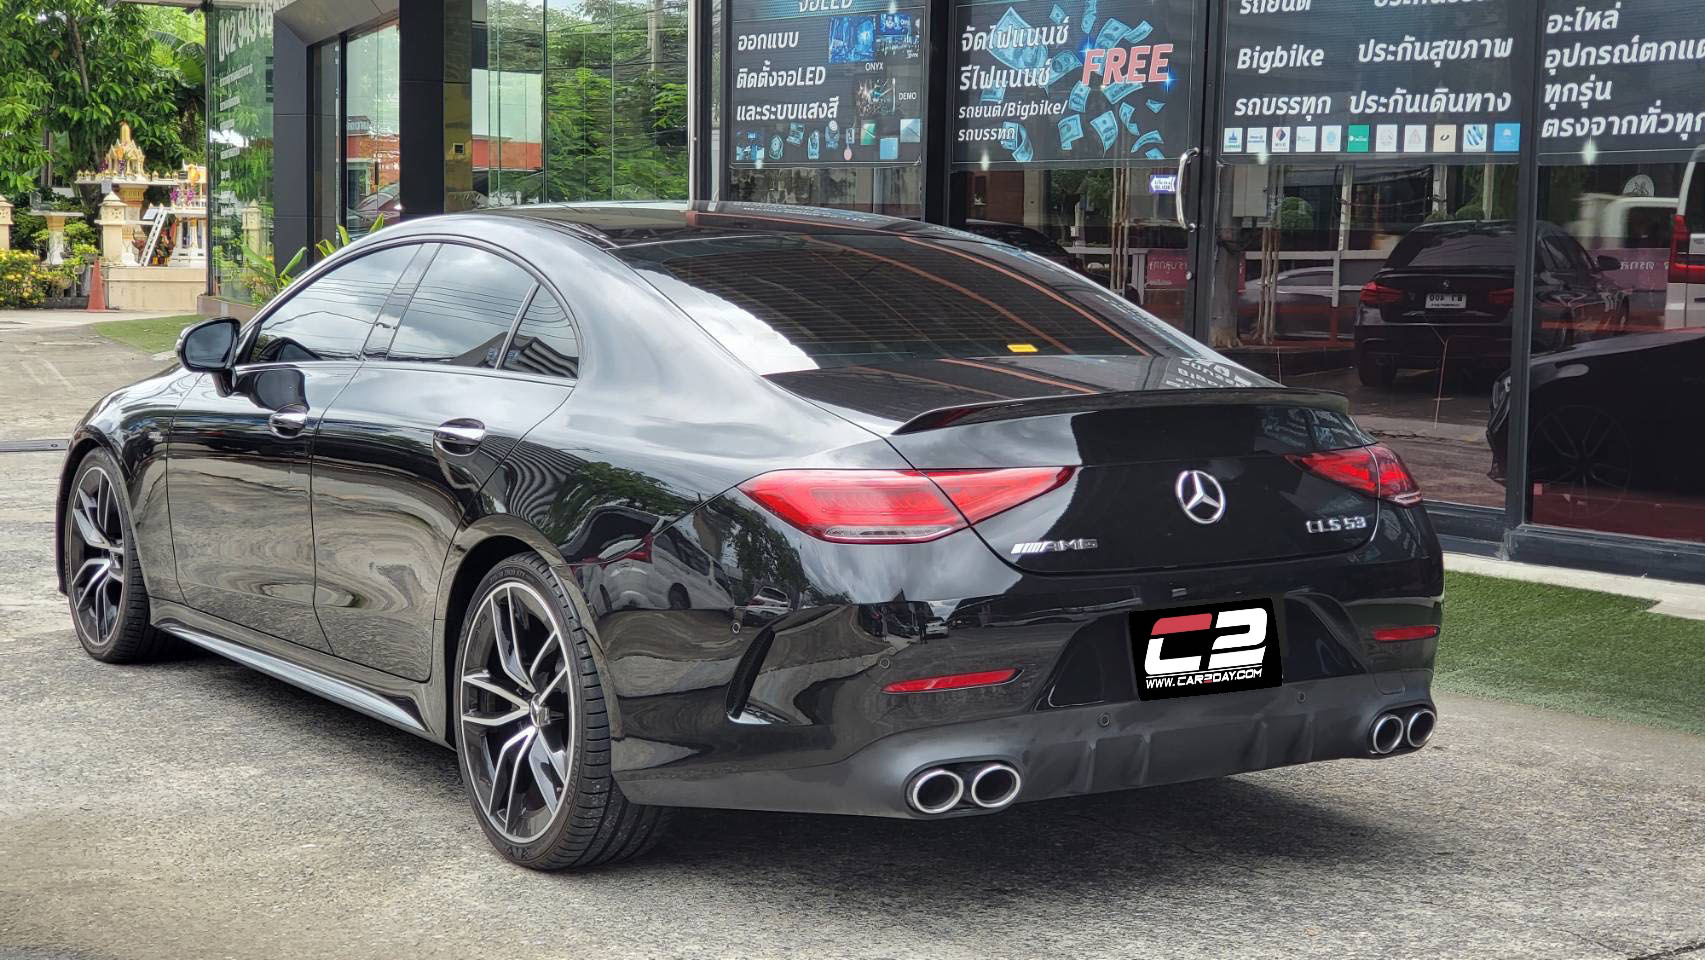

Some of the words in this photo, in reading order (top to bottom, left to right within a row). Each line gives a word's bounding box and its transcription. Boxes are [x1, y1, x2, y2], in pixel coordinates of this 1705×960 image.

[1546, 1, 1622, 34] อะไหล่
[737, 31, 799, 51] ออกแบบ
[961, 16, 1070, 52] จัดไฟแนนซ์
[865, 62, 884, 72] ONYX
[1081, 43, 1174, 87] FREE
[1237, 44, 1325, 74] Bigbike
[1358, 35, 1514, 68] ประกันสุขภาพ
[736, 60, 826, 89] ติดตั้งจอLED
[959, 58, 1052, 91] รีไฟแนนซ์
[1234, 95, 1332, 122] รถบรรทุก
[1350, 87, 1512, 114] ประกันเดินทาง
[1544, 74, 1613, 110] ทุกรุ่น
[736, 96, 840, 121] และระบบแสงสี
[957, 127, 1016, 145] รถบรรทุก
[1306, 519, 1341, 533] CLS
[1344, 516, 1367, 530] 53
